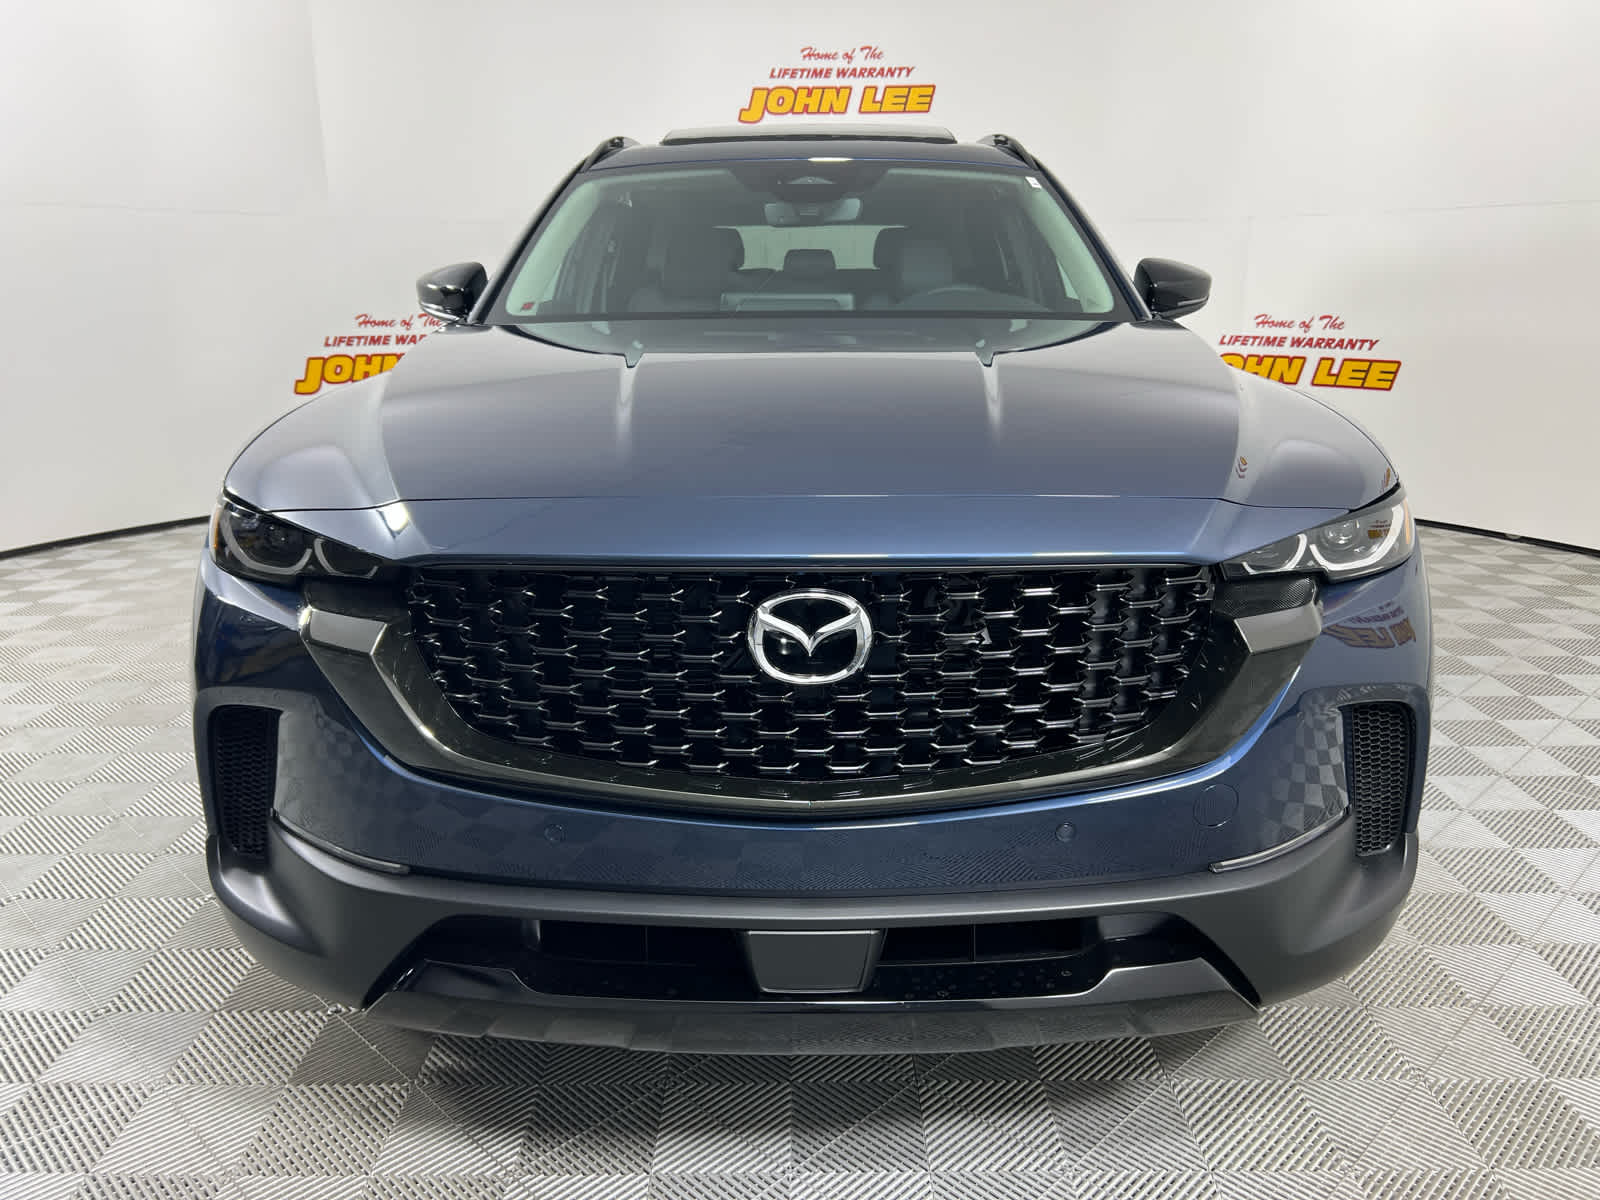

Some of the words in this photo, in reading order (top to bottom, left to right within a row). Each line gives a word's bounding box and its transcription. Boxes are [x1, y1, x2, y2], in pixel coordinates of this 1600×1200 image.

[800, 46, 838, 61] Home
[842, 48, 856, 64] of
[859, 45, 884, 60] The
[769, 67, 833, 79] LIFETIME
[836, 66, 915, 79] WARRANTY
[738, 85, 852, 124] JOHN
[858, 84, 936, 114] LEE
[355, 313, 395, 328] Home
[399, 315, 414, 331] of
[417, 313, 442, 327] The
[1254, 313, 1295, 329] Home
[1299, 316, 1315, 333] of
[1319, 314, 1345, 330] The
[323, 335, 391, 347] LIFETIME
[1219, 335, 1288, 348] LIFETIME
[1289, 337, 1380, 351] WARRANTY
[1310, 357, 1402, 391] LEE
